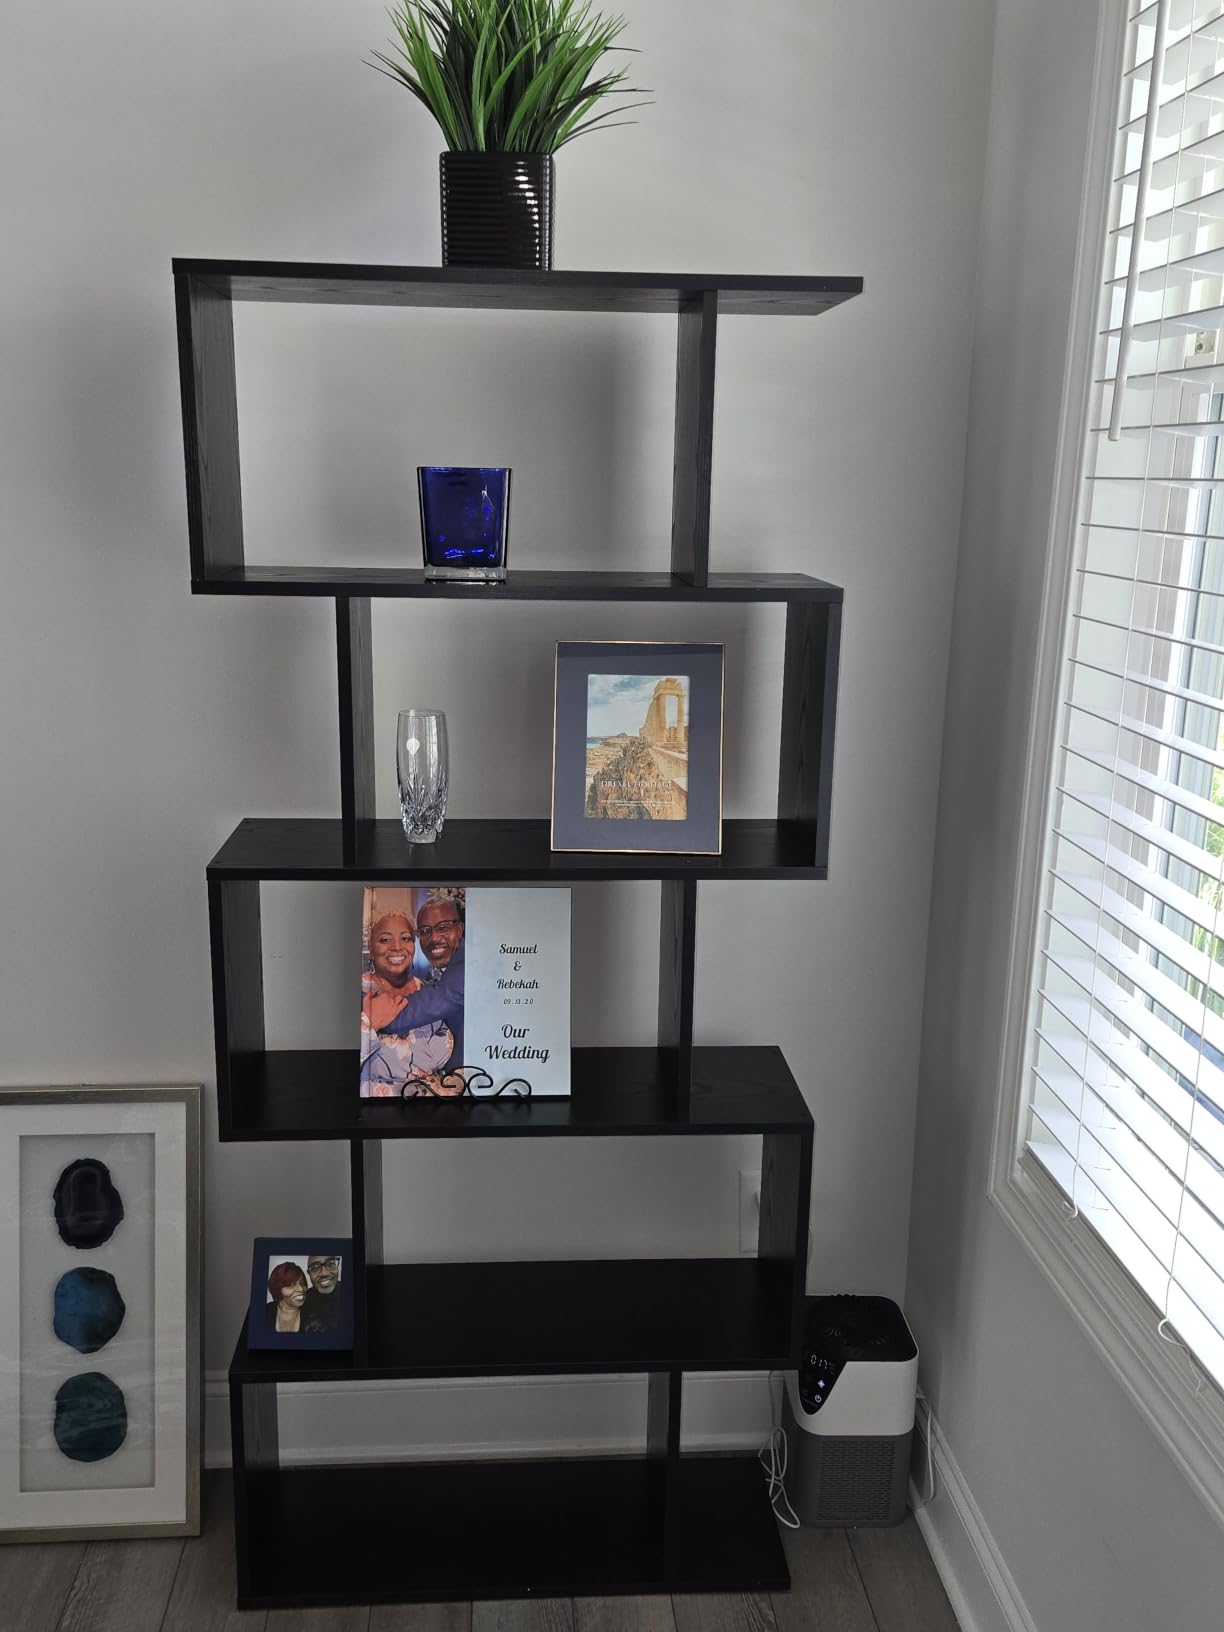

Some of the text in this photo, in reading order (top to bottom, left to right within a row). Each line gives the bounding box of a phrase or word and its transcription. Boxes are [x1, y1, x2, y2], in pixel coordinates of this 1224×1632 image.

[601, 780, 672, 789] DREXEL HERITAGE
[499, 943, 538, 954] Samuel
[513, 961, 522, 971] &
[496, 979, 540, 989] Rebekah
[501, 1024, 530, 1038] Our
[485, 1045, 550, 1063] Wedding
